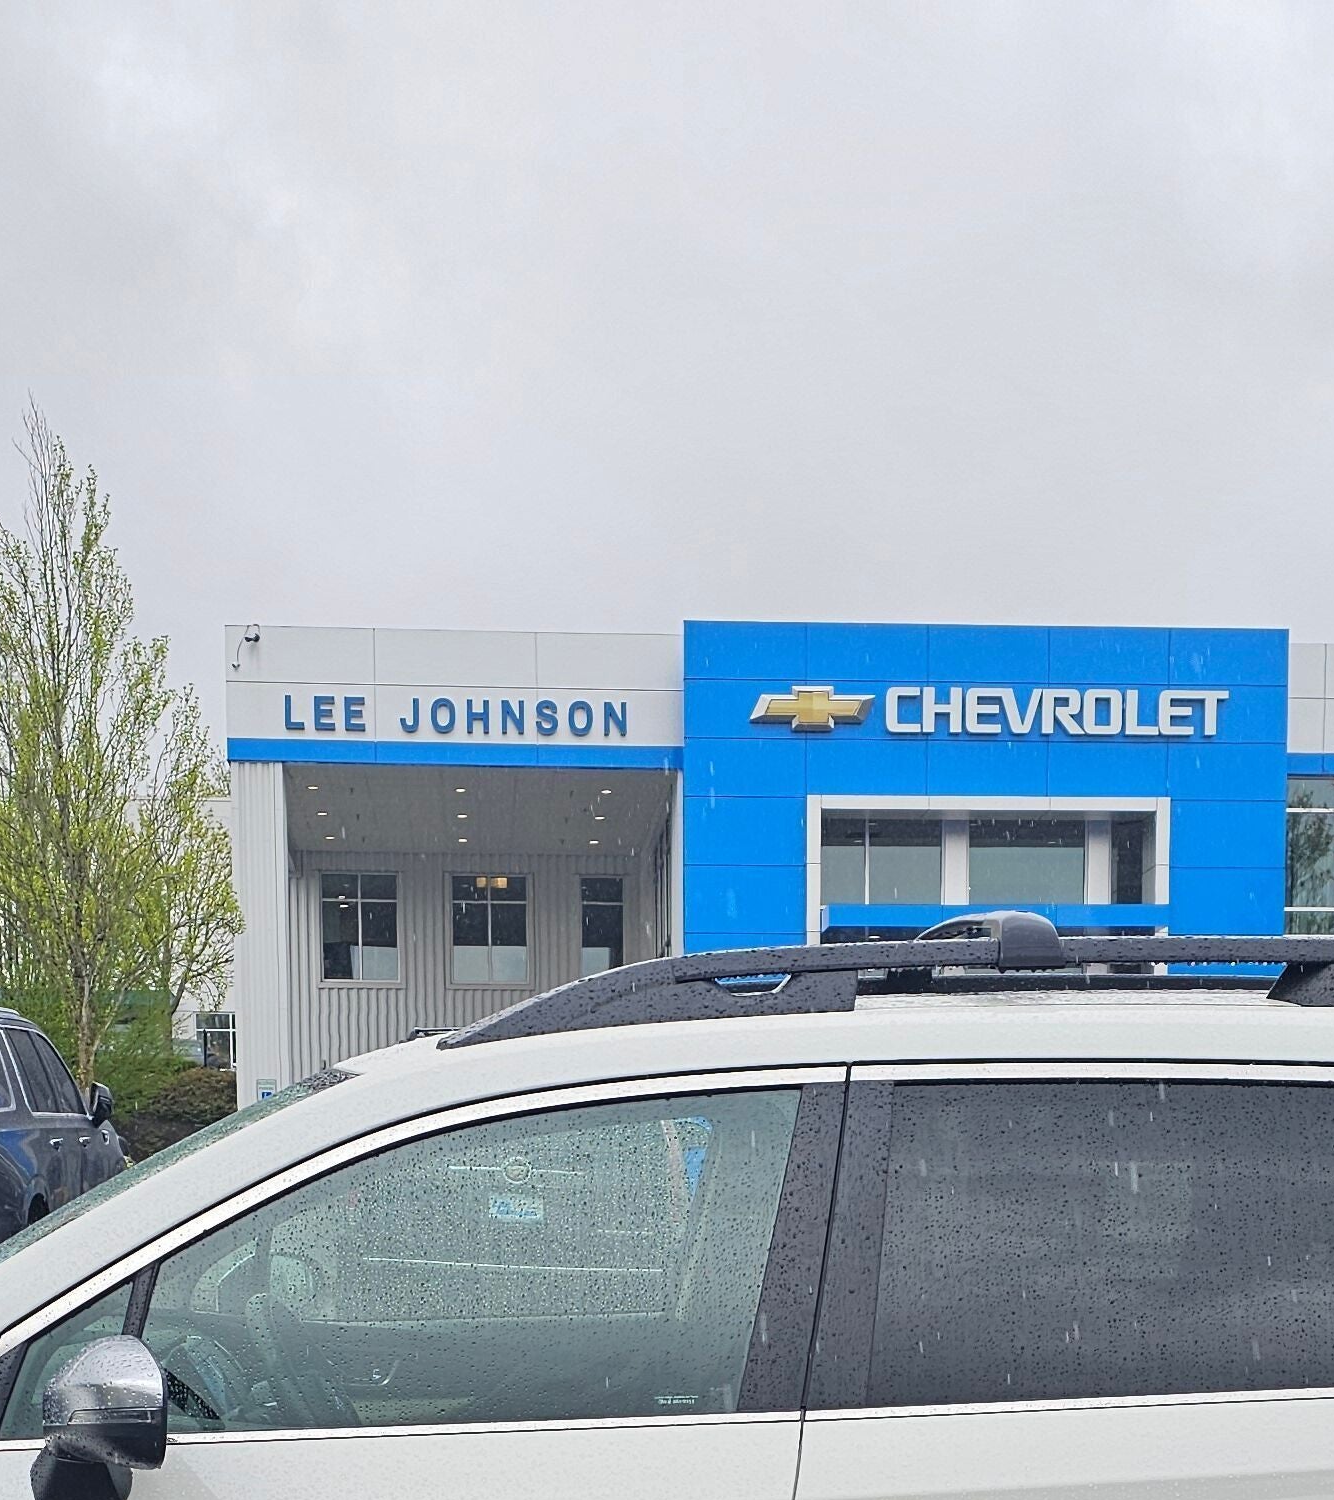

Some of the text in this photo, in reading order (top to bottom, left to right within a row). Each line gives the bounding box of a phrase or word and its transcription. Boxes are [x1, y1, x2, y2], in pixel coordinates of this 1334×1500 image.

[284, 695, 628, 737] LEE JOHNSON
[885, 686, 1229, 736] CHEVROLET
